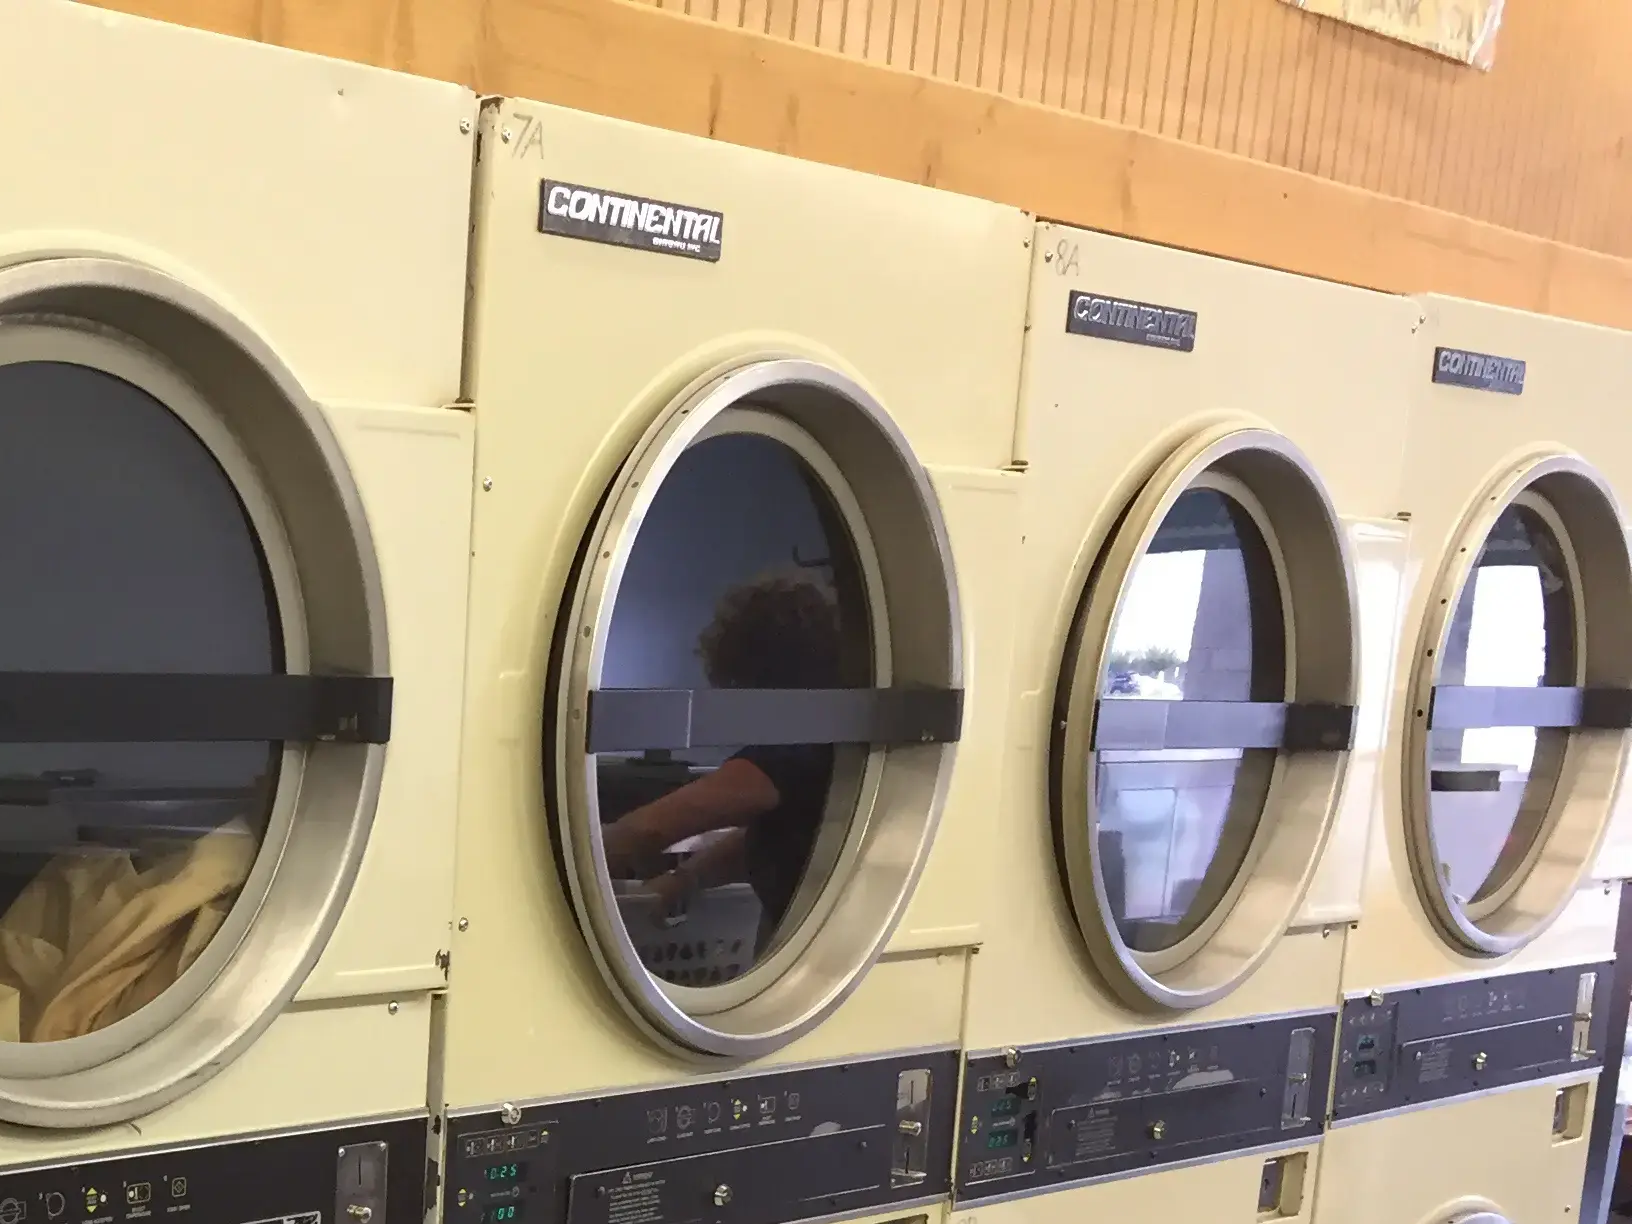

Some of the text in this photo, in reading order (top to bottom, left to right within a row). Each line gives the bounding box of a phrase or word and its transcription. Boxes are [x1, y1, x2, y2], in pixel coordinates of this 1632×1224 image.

[511, 112, 544, 160] 7A
[547, 186, 721, 244] CONTINENTAL
[1055, 239, 1080, 277] 8A
[1073, 295, 1196, 339] CONTINENTAL
